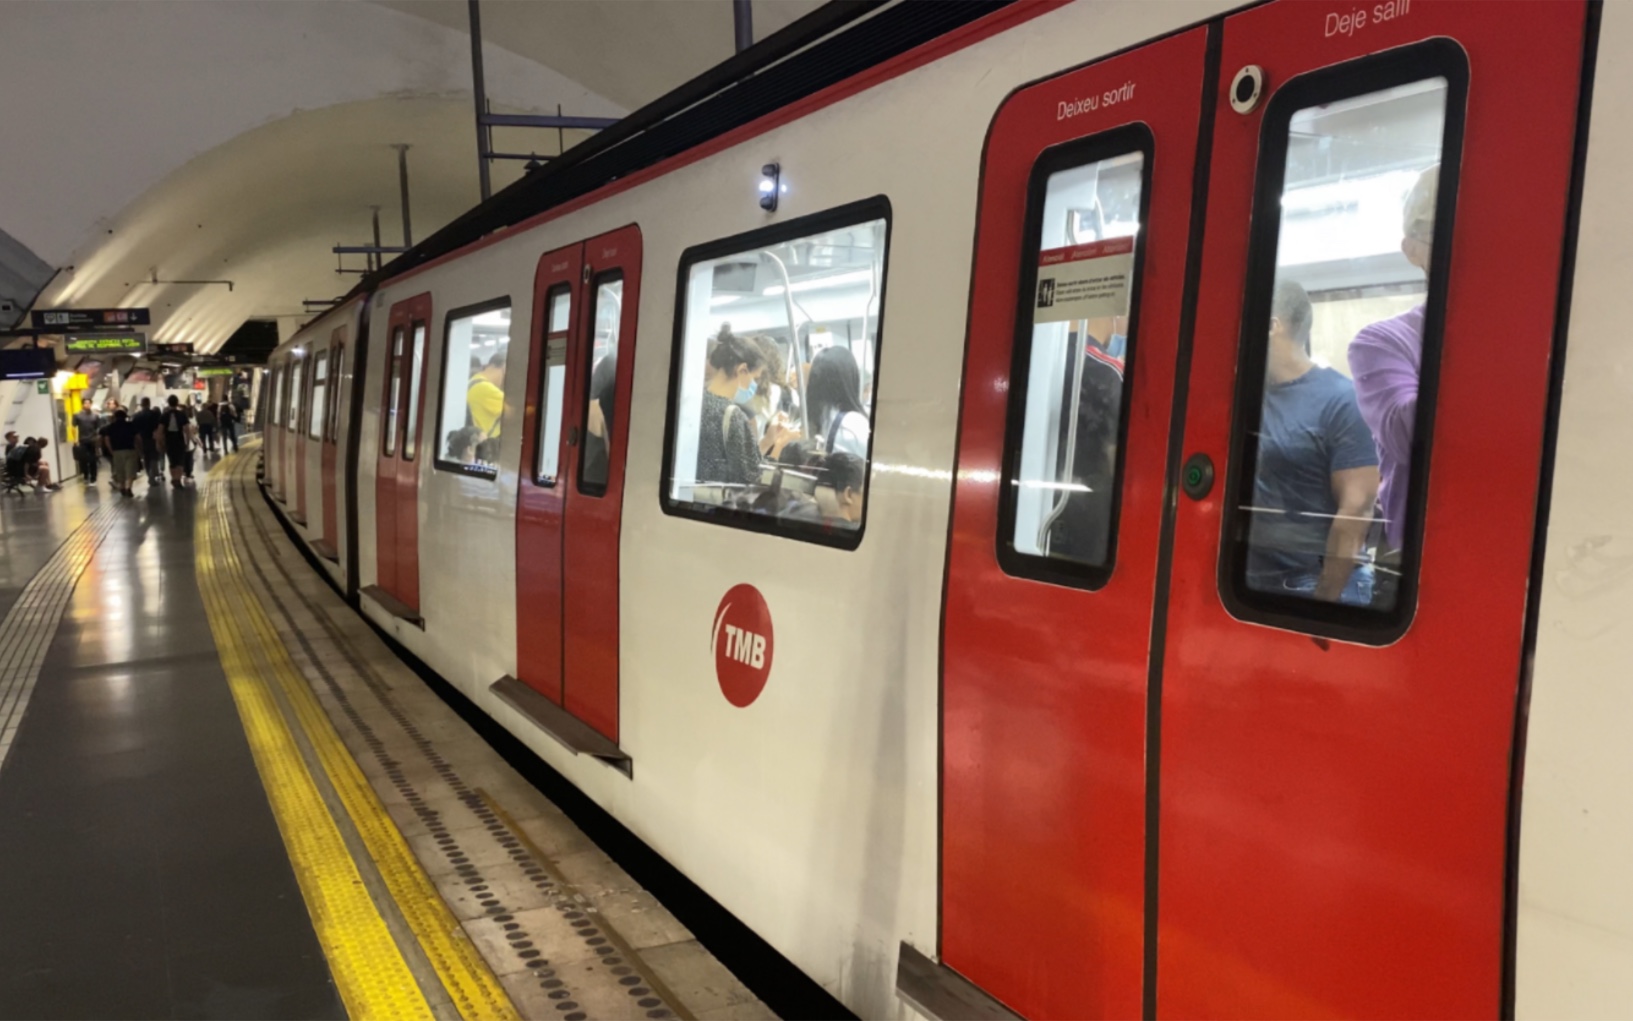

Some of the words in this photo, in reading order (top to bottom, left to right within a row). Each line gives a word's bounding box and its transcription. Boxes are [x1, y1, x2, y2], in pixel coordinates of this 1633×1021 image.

[1325, 7, 1367, 38] Deje
[1057, 95, 1100, 121] Deixeu
[1102, 81, 1136, 107] sortir
[725, 623, 767, 670] TMB
